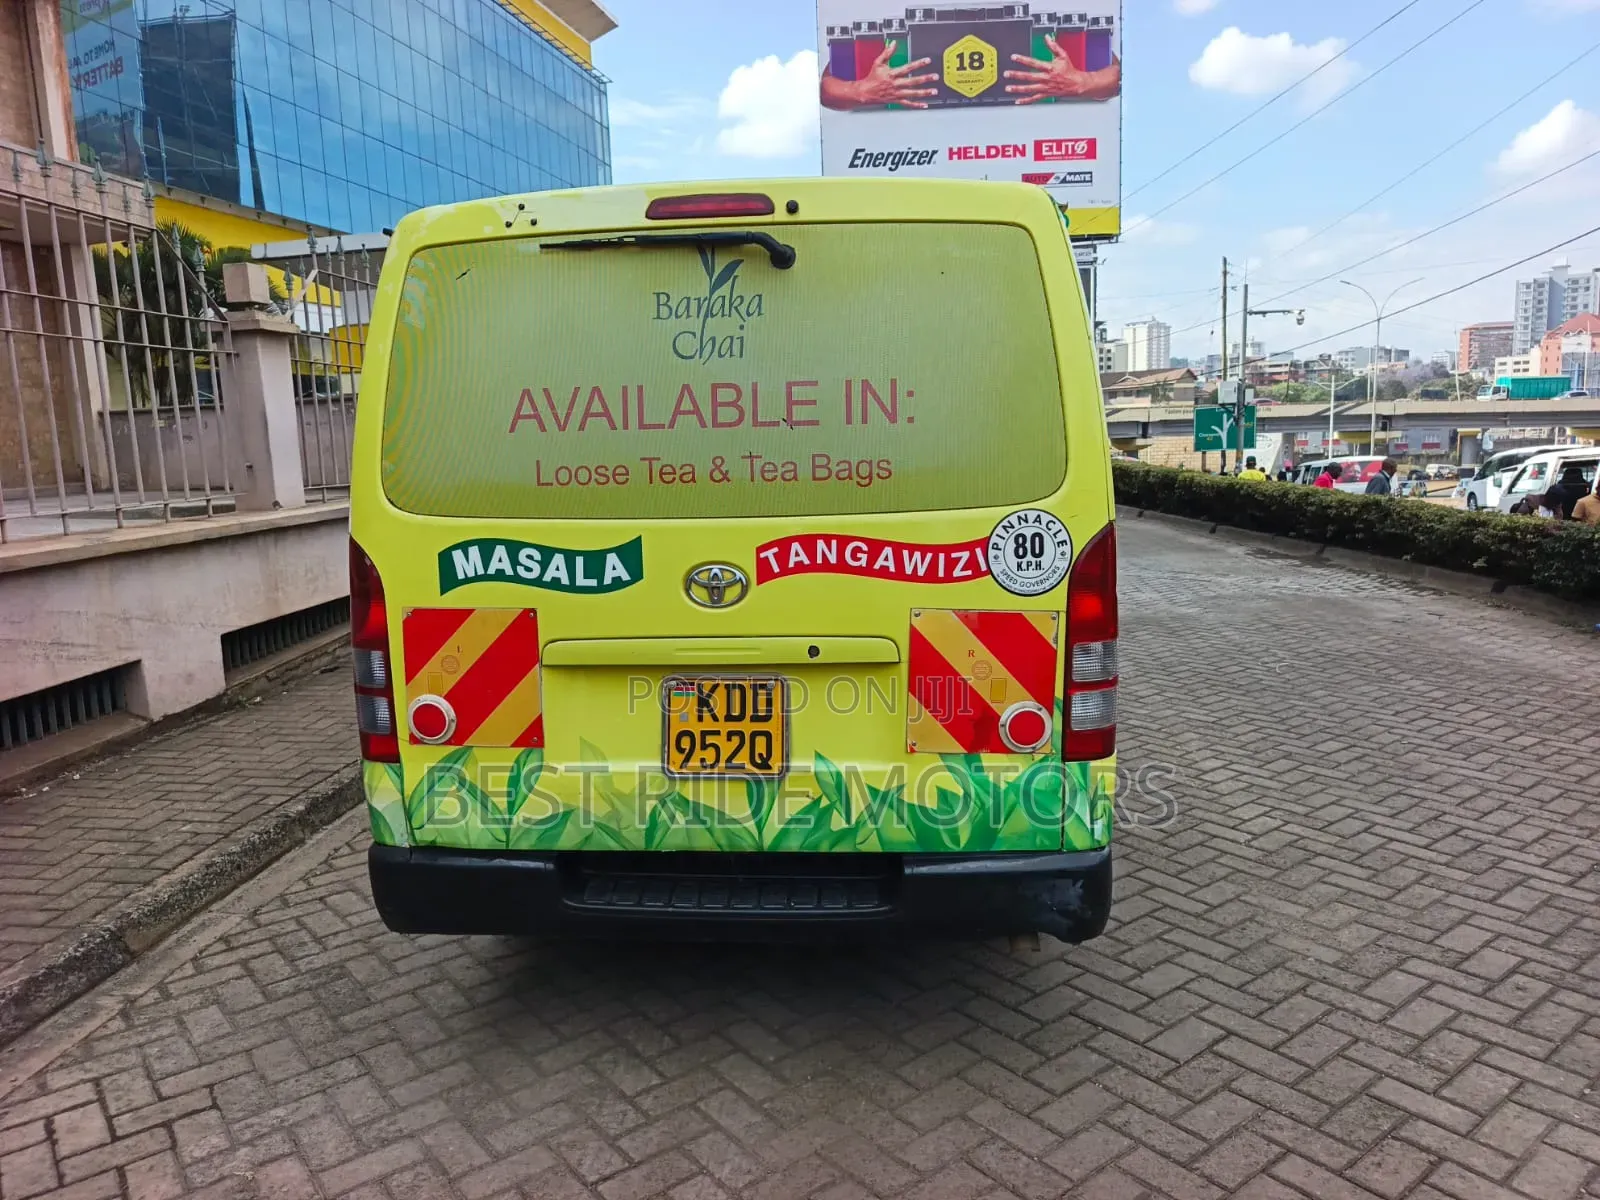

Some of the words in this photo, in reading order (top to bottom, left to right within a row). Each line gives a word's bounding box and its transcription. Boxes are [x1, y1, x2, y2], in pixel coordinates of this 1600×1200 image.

[956, 51, 985, 71] 18
[848, 147, 939, 172] Energizer
[948, 144, 1026, 161] HELDEN
[1065, 174, 1091, 182] MATE
[652, 275, 764, 323] Baraka
[672, 325, 745, 366] Chai
[508, 380, 821, 434] AVAILABLE
[845, 377, 915, 426] IN:
[535, 459, 630, 488] Loose
[640, 456, 697, 486] Tea
[709, 455, 731, 484] &
[741, 453, 799, 484] Tea
[811, 453, 893, 488] Bags
[991, 513, 1068, 552] PINNACLE
[1013, 532, 1045, 560] 80
[451, 543, 631, 588] MASALA
[759, 539, 989, 578] TANGAWIZI
[1000, 568, 1018, 585] SPEED
[1020, 565, 1061, 589] GOVERNORS
[1016, 560, 1045, 572] K.P.H.
[696, 682, 775, 723] KDD
[675, 730, 774, 771] 952Q
